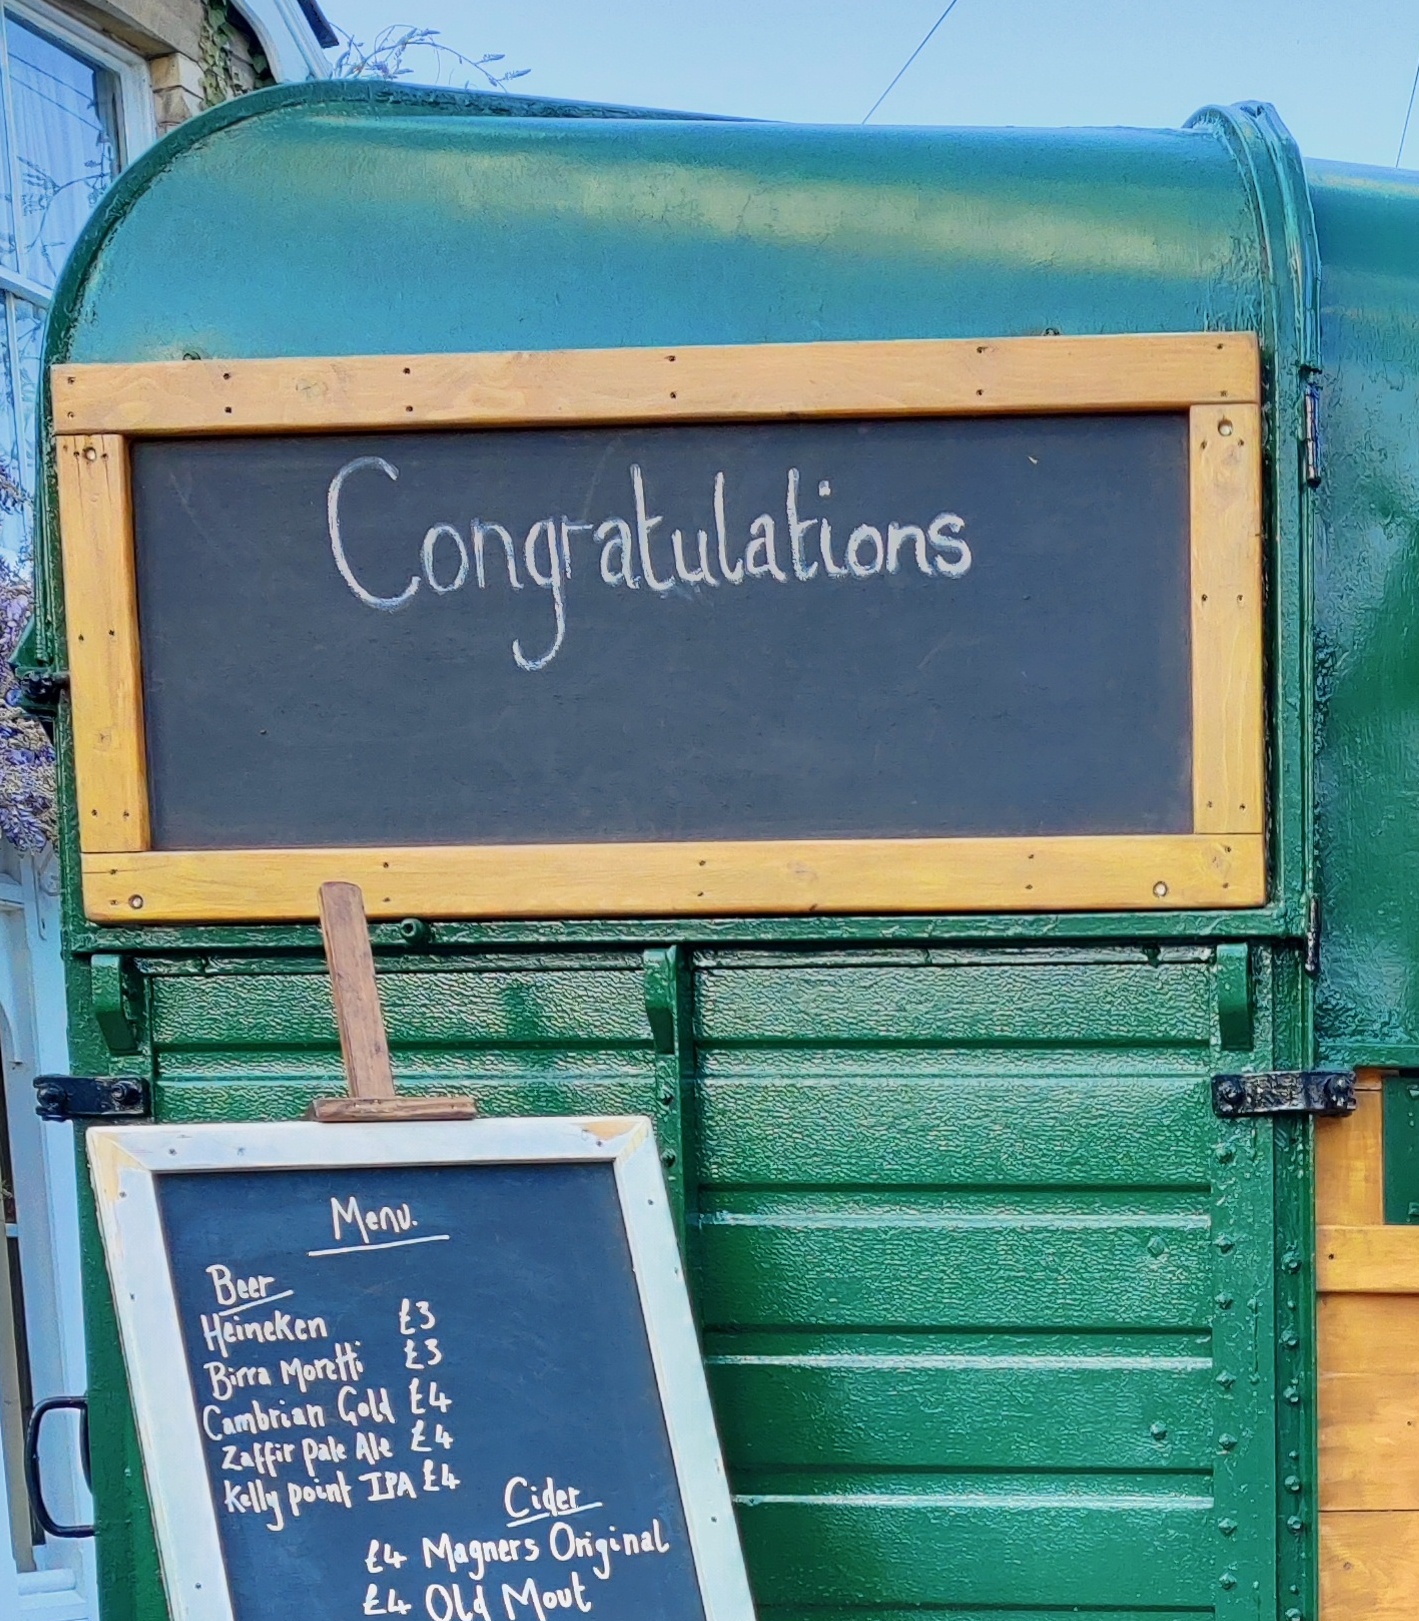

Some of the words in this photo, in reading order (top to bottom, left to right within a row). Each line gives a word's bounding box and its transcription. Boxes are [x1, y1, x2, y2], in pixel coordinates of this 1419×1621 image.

[327, 455, 972, 671] Congratulations
[205, 1263, 276, 1306] Beer
[200, 1309, 328, 1358] Heineken
[399, 1298, 436, 1335] £3
[203, 1361, 271, 1400] Birra
[280, 1340, 364, 1393] Moretti
[404, 1338, 442, 1369] £3
[202, 1400, 326, 1441] Cambrian
[337, 1385, 395, 1426] Gold
[409, 1377, 453, 1414] £4
[221, 1440, 295, 1478] Zaffir
[356, 1432, 393, 1465] Ale
[411, 1419, 454, 1451] £4
[224, 1479, 284, 1532] Kelly
[359, 1471, 417, 1502] IPA
[422, 1458, 461, 1491] £4
[504, 1476, 580, 1518] Cider
[365, 1539, 407, 1574] £4
[422, 1533, 540, 1580] Magners
[550, 1518, 670, 1580] Original
[363, 1583, 412, 1616] £4
